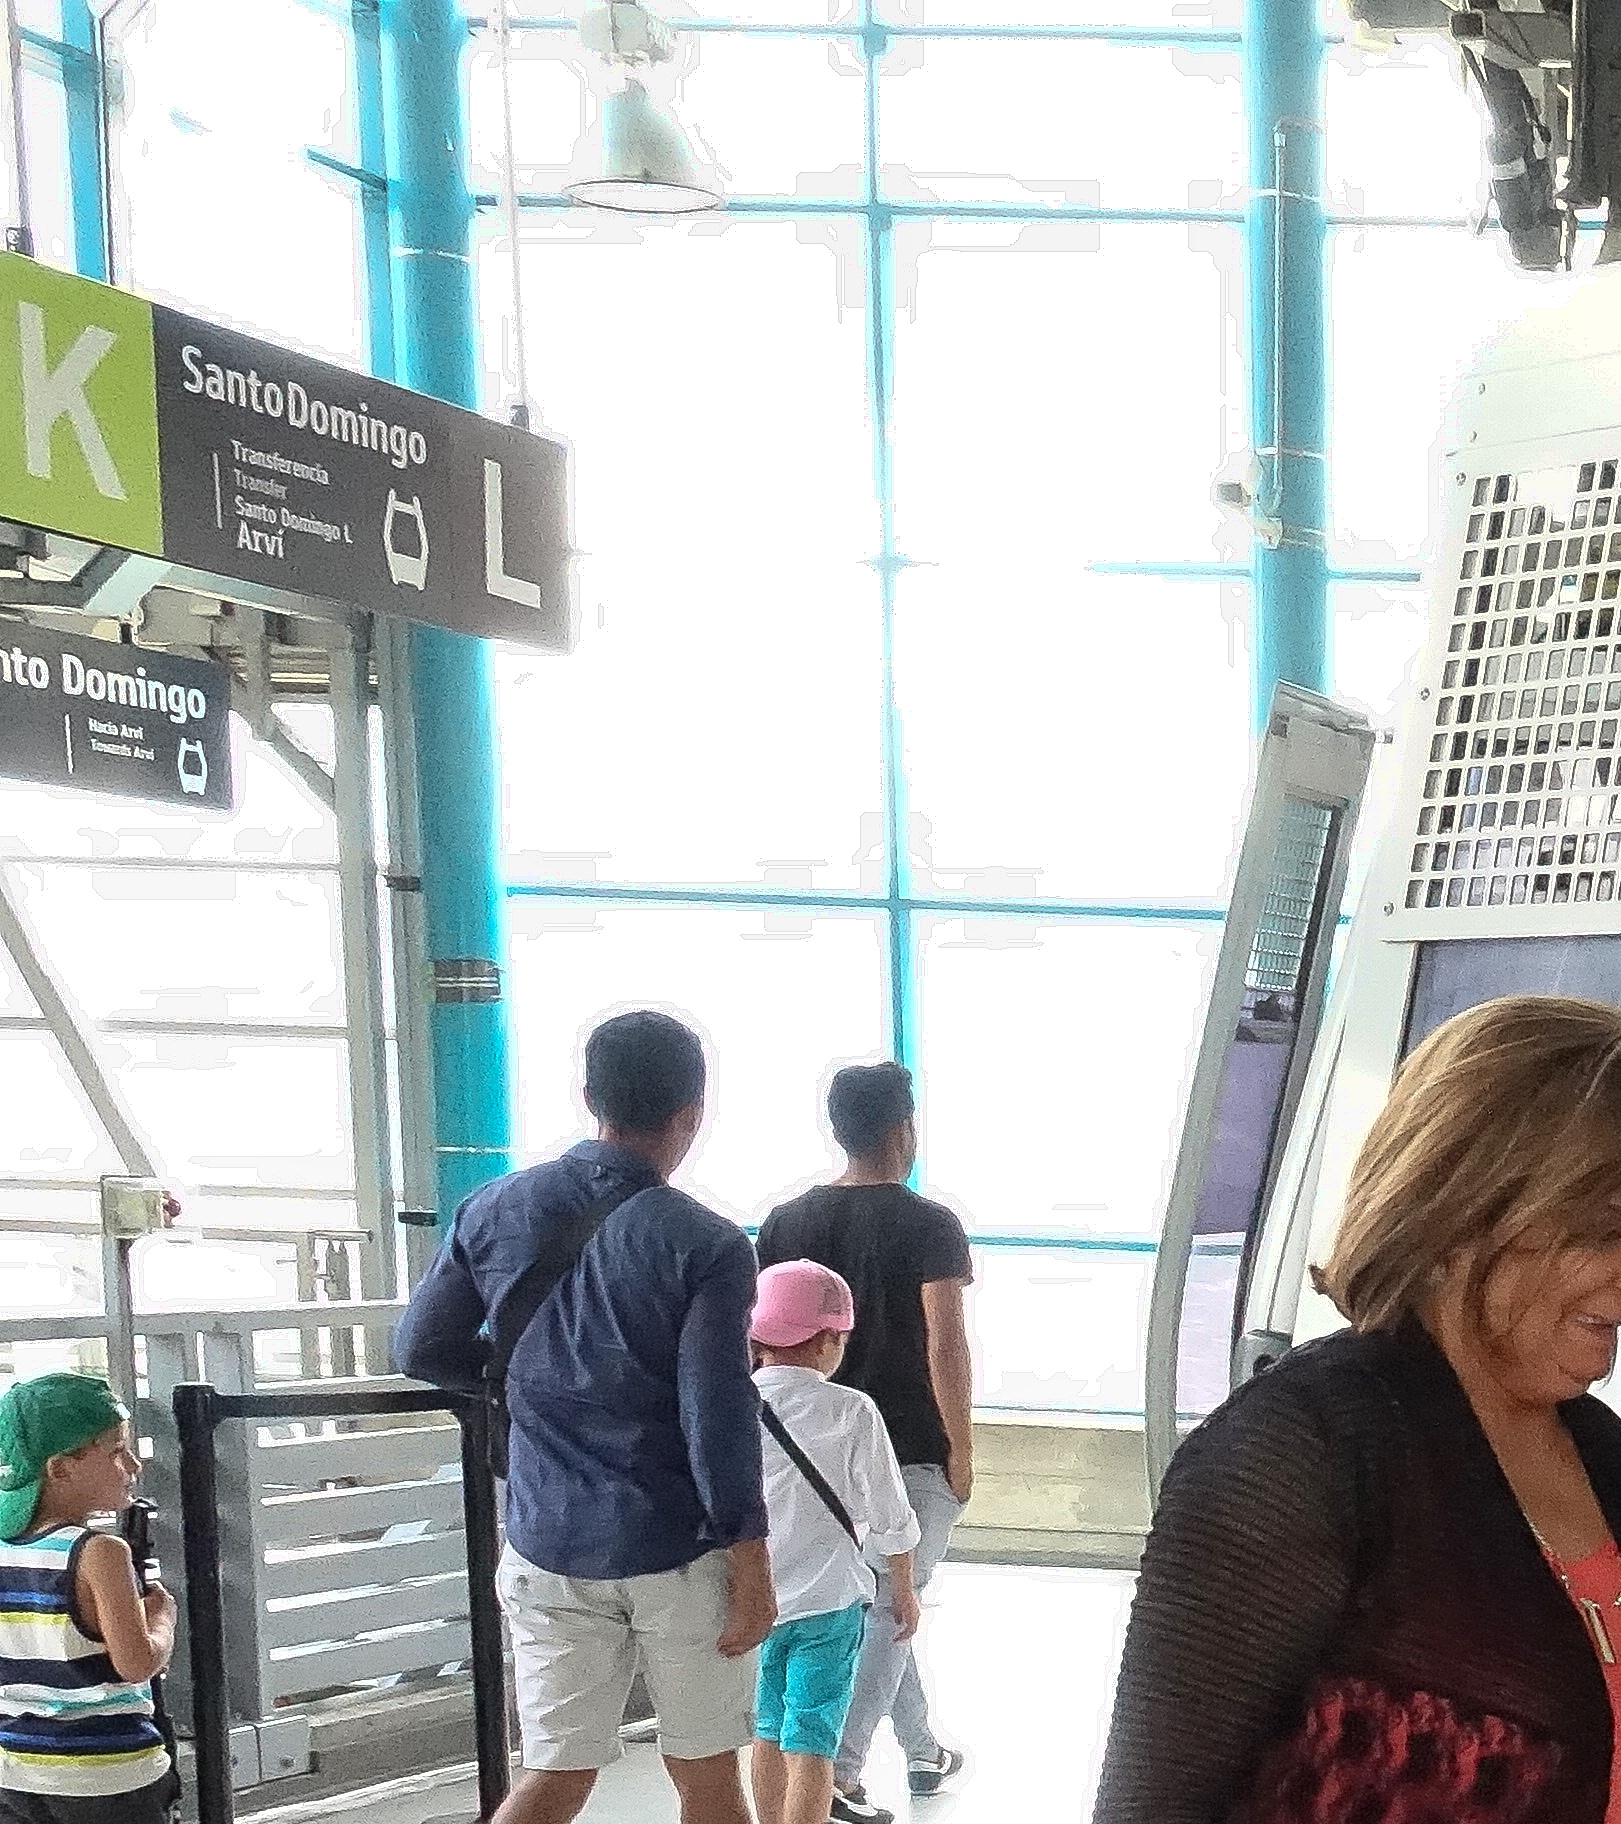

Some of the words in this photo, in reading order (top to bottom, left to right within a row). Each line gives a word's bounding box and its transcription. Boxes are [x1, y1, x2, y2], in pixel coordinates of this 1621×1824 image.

[17, 299, 127, 502] K
[231, 438, 330, 486] Transferencia
[235, 494, 277, 524] Santo
[281, 506, 341, 543] Domingo
[343, 522, 353, 544] L
[483, 458, 541, 609] L
[61, 652, 206, 724] Domingo
